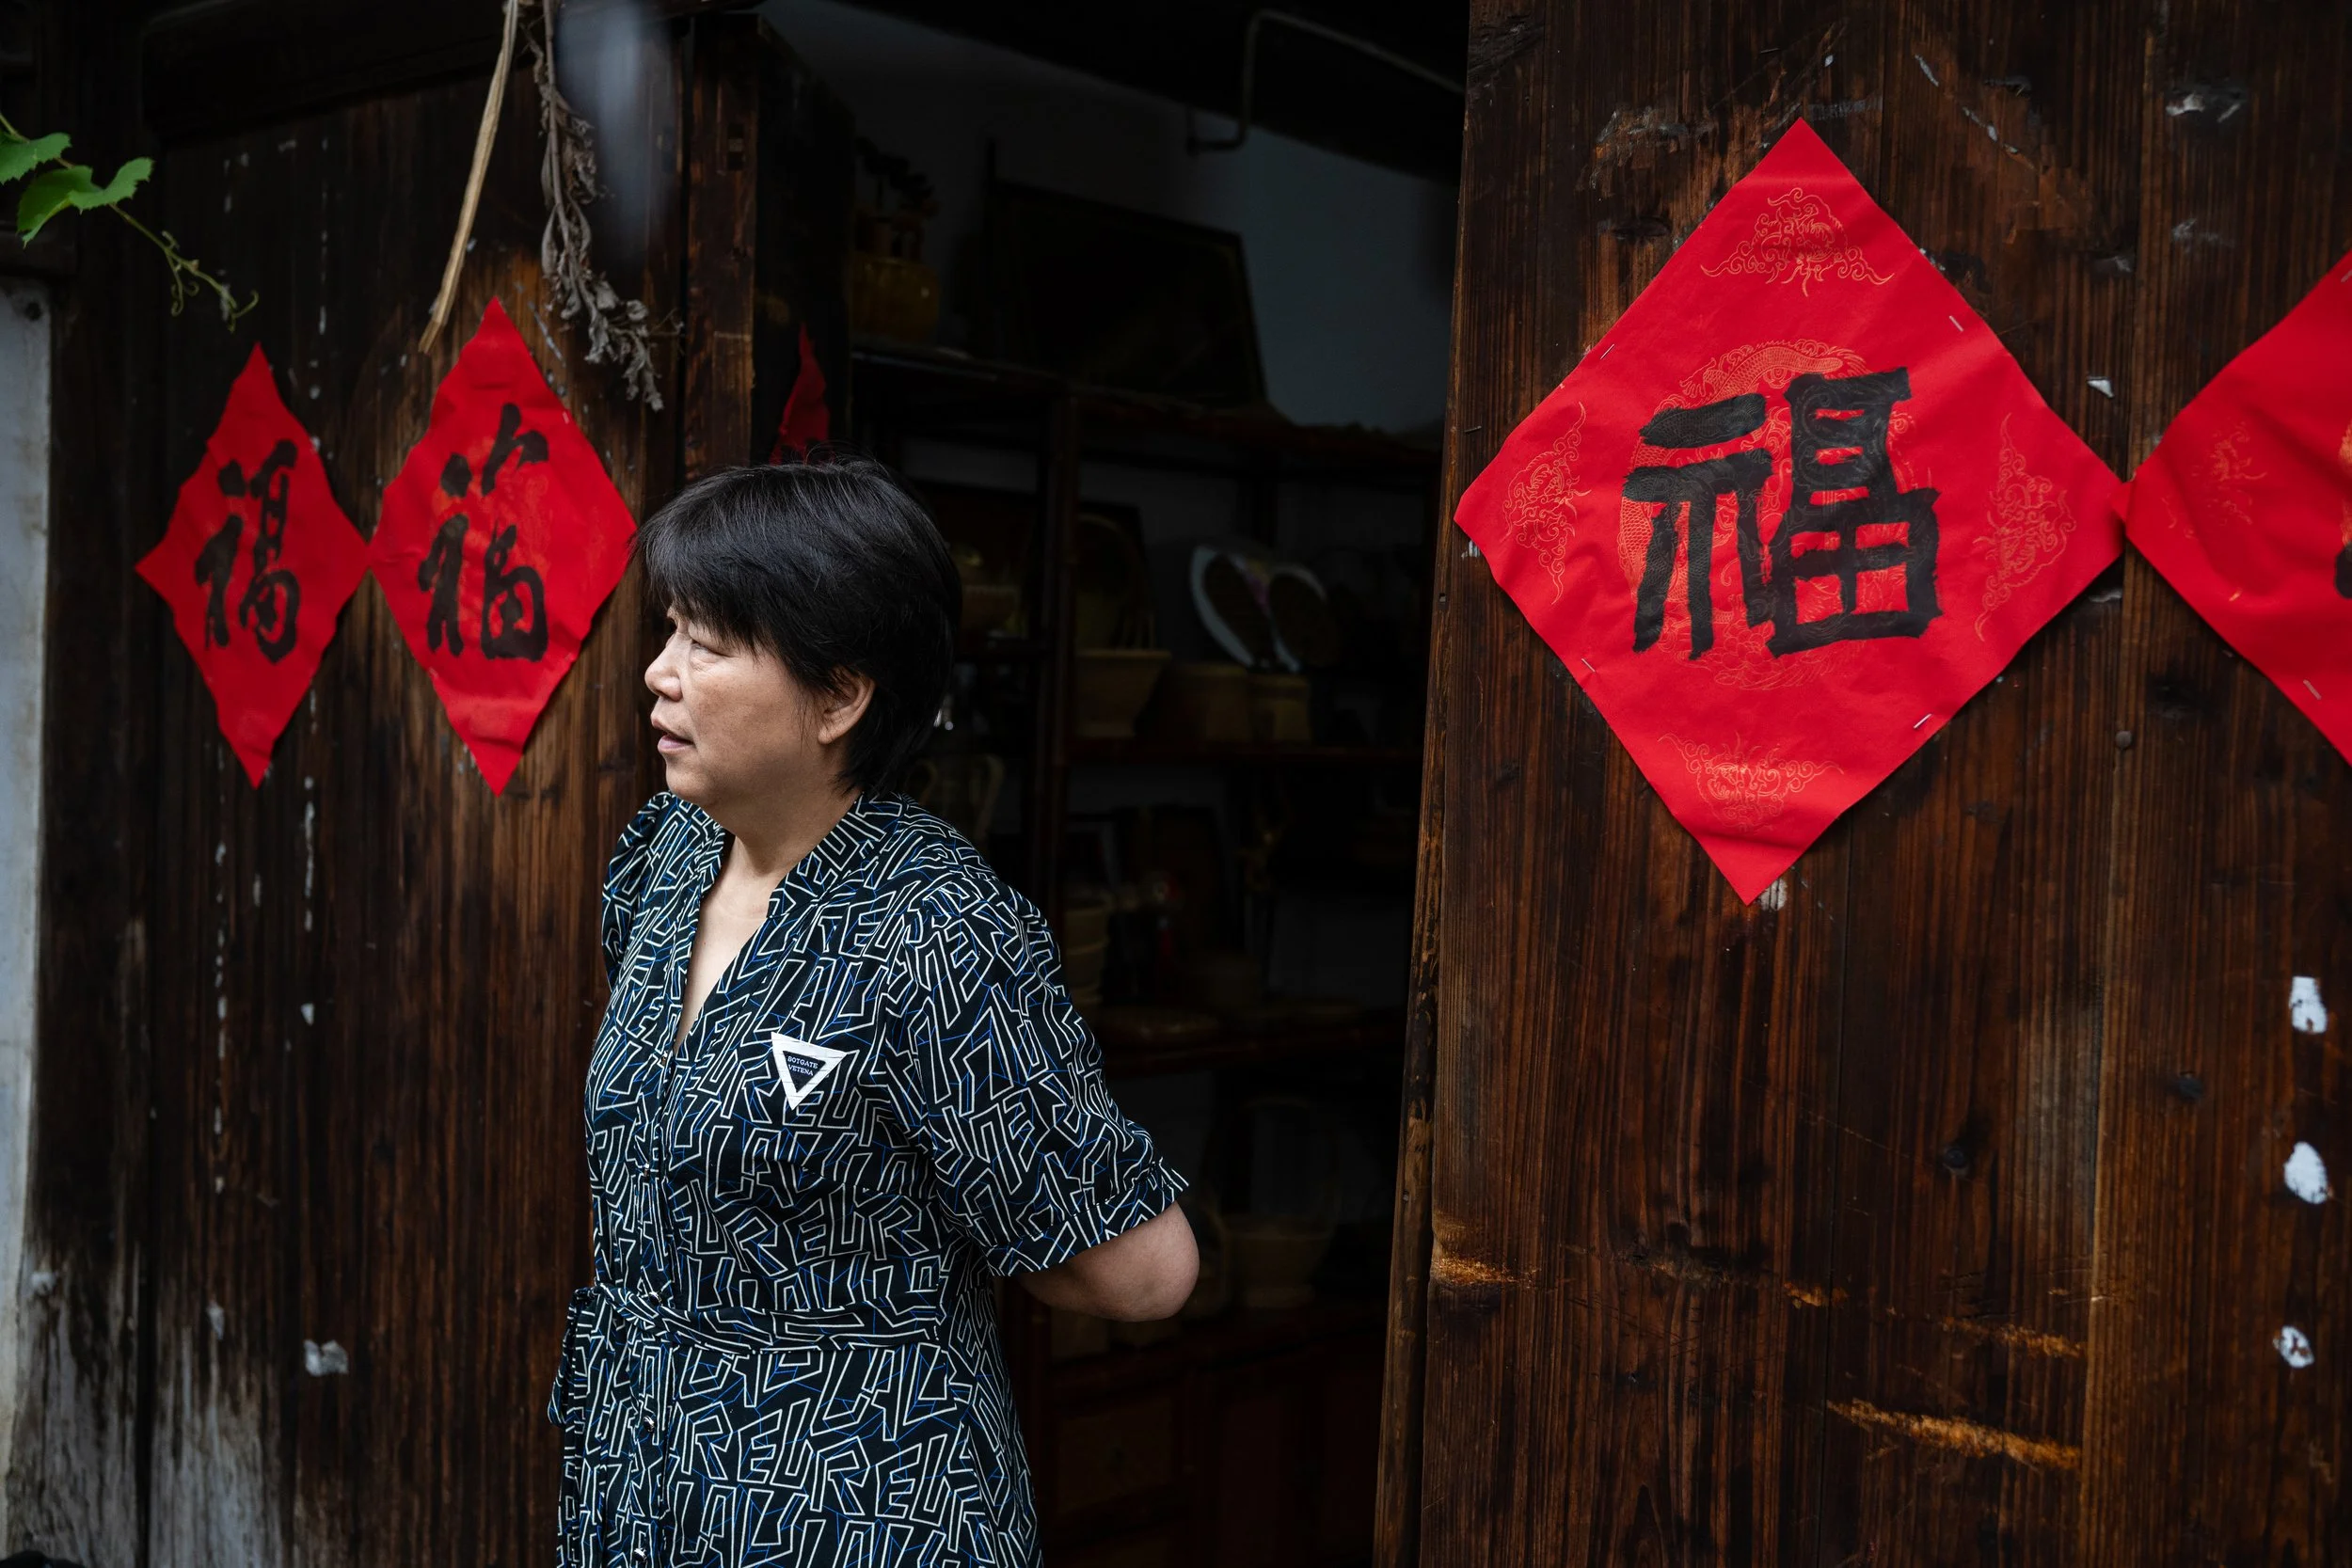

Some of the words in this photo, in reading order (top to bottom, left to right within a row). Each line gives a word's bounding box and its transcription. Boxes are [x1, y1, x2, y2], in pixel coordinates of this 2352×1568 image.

[195, 439, 300, 663] 福
[418, 403, 548, 662] 福
[1622, 366, 1942, 660] 福
